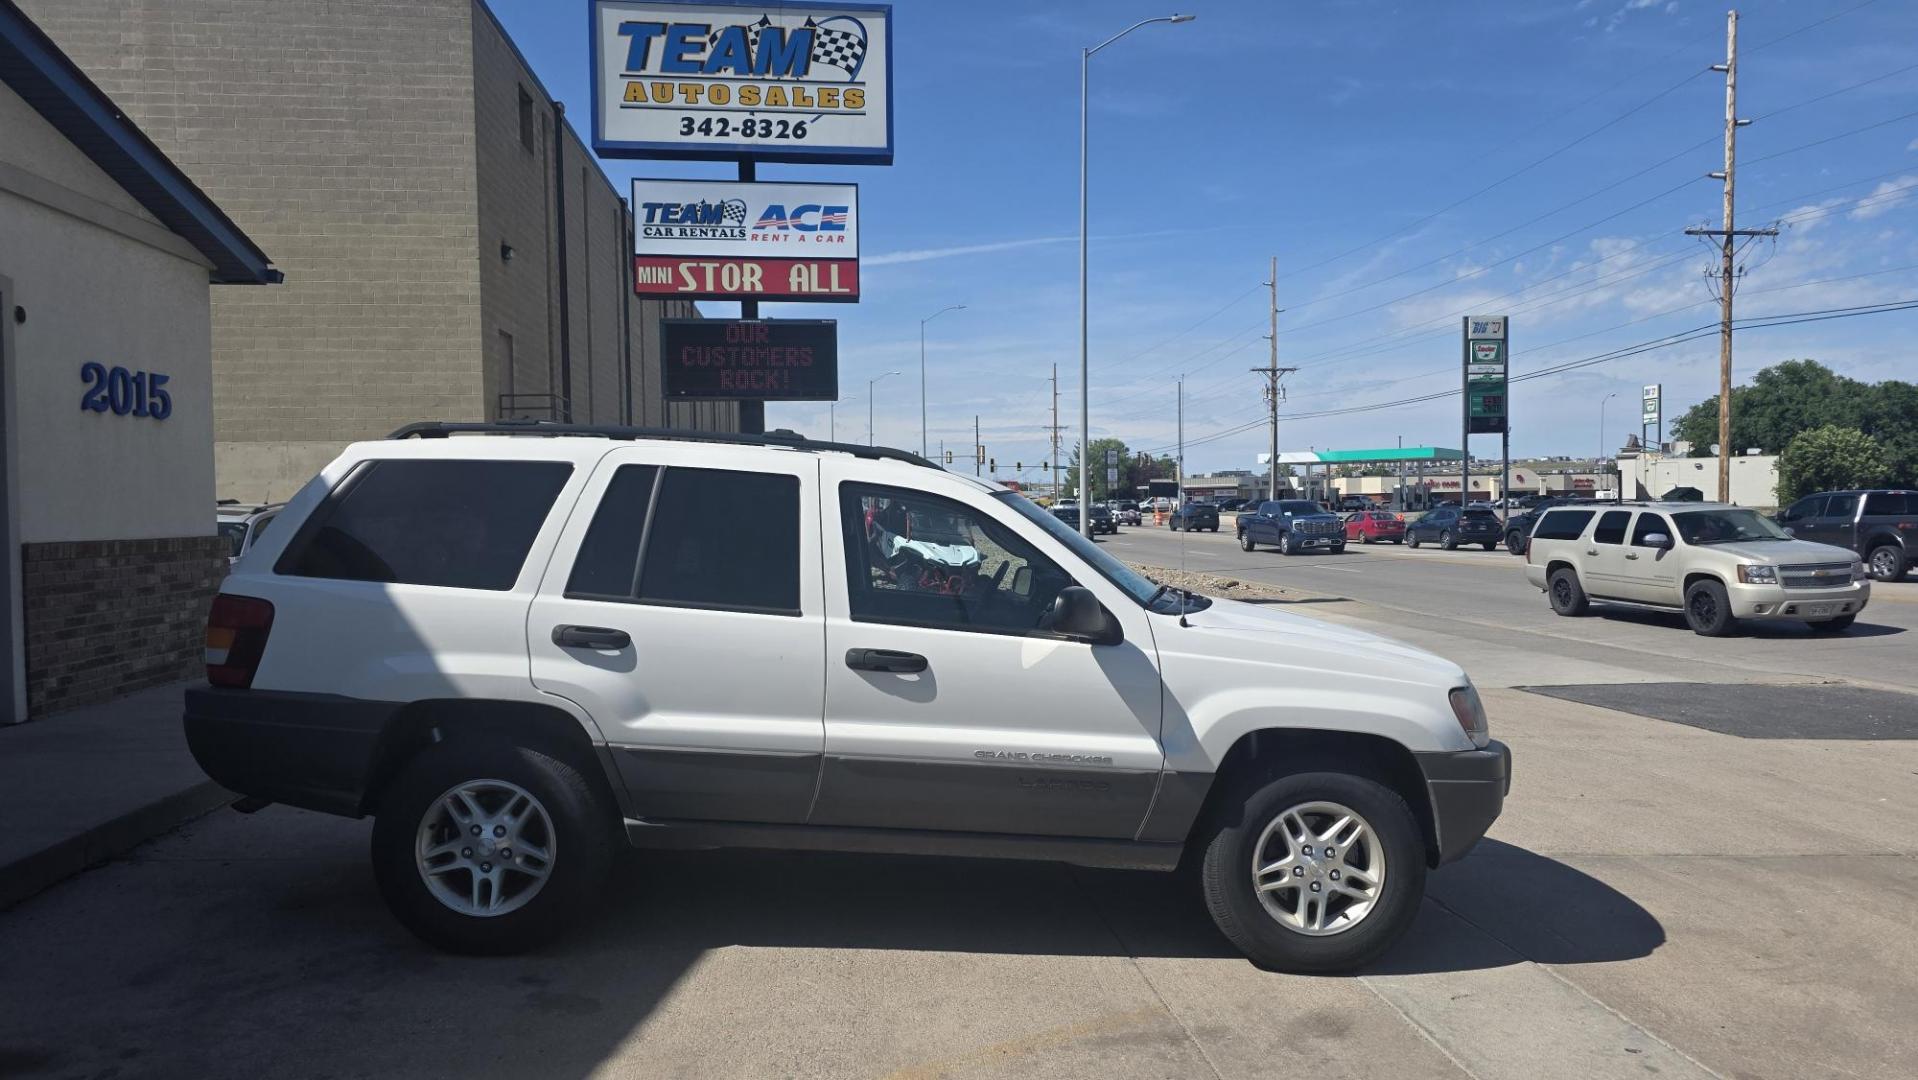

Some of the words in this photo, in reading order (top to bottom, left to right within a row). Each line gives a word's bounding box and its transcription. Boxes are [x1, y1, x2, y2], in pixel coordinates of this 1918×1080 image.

[618, 21, 817, 78] TEAM
[623, 81, 731, 105] AUTO
[738, 84, 866, 109] SALES
[679, 116, 807, 139] 342-8326
[642, 202, 723, 225] TEAM
[752, 204, 848, 232] ACE
[643, 227, 675, 237] CAR
[679, 228, 746, 238] RENTALS
[750, 233, 789, 242] RENT
[798, 234, 806, 242] A
[815, 234, 845, 243] CAR
[638, 266, 672, 284] MINI
[678, 262, 763, 292] STOR
[789, 263, 850, 293] ALL
[726, 323, 769, 344] OUR
[682, 346, 814, 367] CUSTOMERS
[81, 362, 172, 420] 2015
[973, 750, 1028, 761] GRAND
[1030, 752, 1113, 765] CHEROKEE
